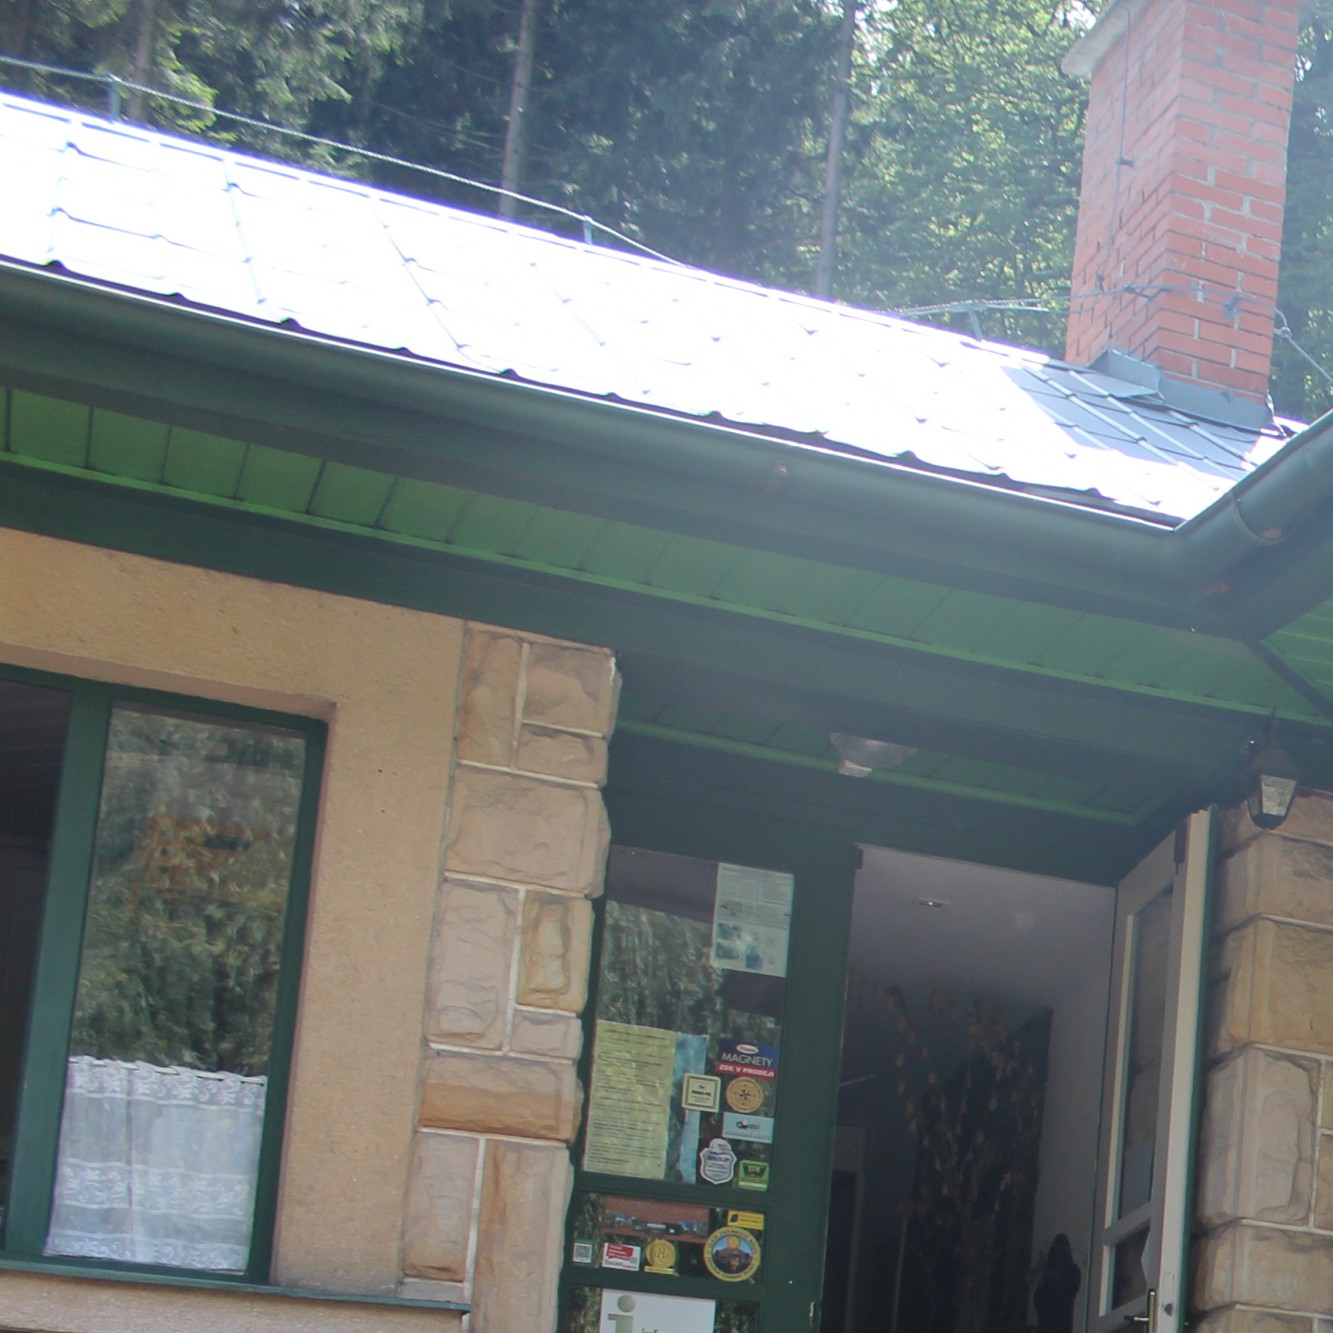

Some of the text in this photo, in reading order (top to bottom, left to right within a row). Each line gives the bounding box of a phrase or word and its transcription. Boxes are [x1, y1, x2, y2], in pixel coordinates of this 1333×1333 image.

[721, 1052, 773, 1068] MAGNETY
[719, 1063, 734, 1072] ZDE
[743, 1067, 775, 1078] PRODEJI
